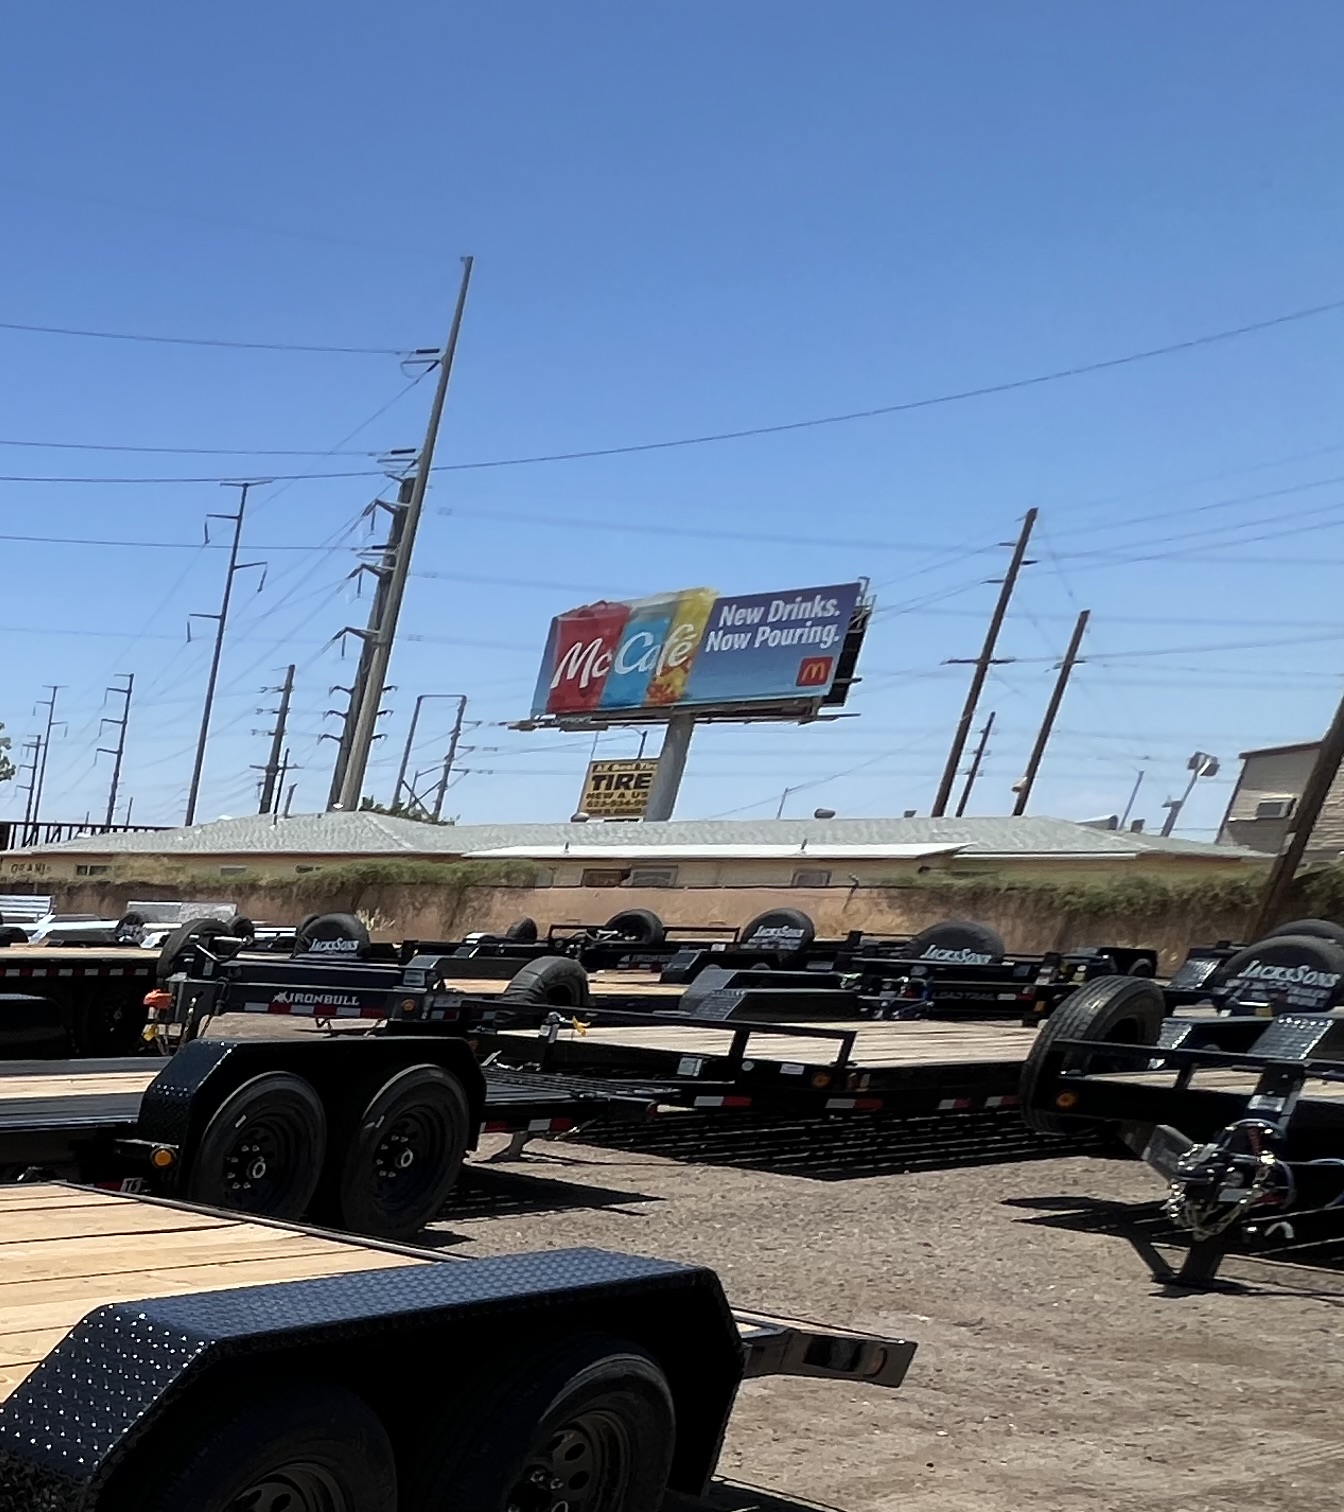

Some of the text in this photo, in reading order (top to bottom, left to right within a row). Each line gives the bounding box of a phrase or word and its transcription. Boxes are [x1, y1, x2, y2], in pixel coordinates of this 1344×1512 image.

[718, 594, 841, 628] New Drinks.
[705, 620, 840, 653] Now Pouring.
